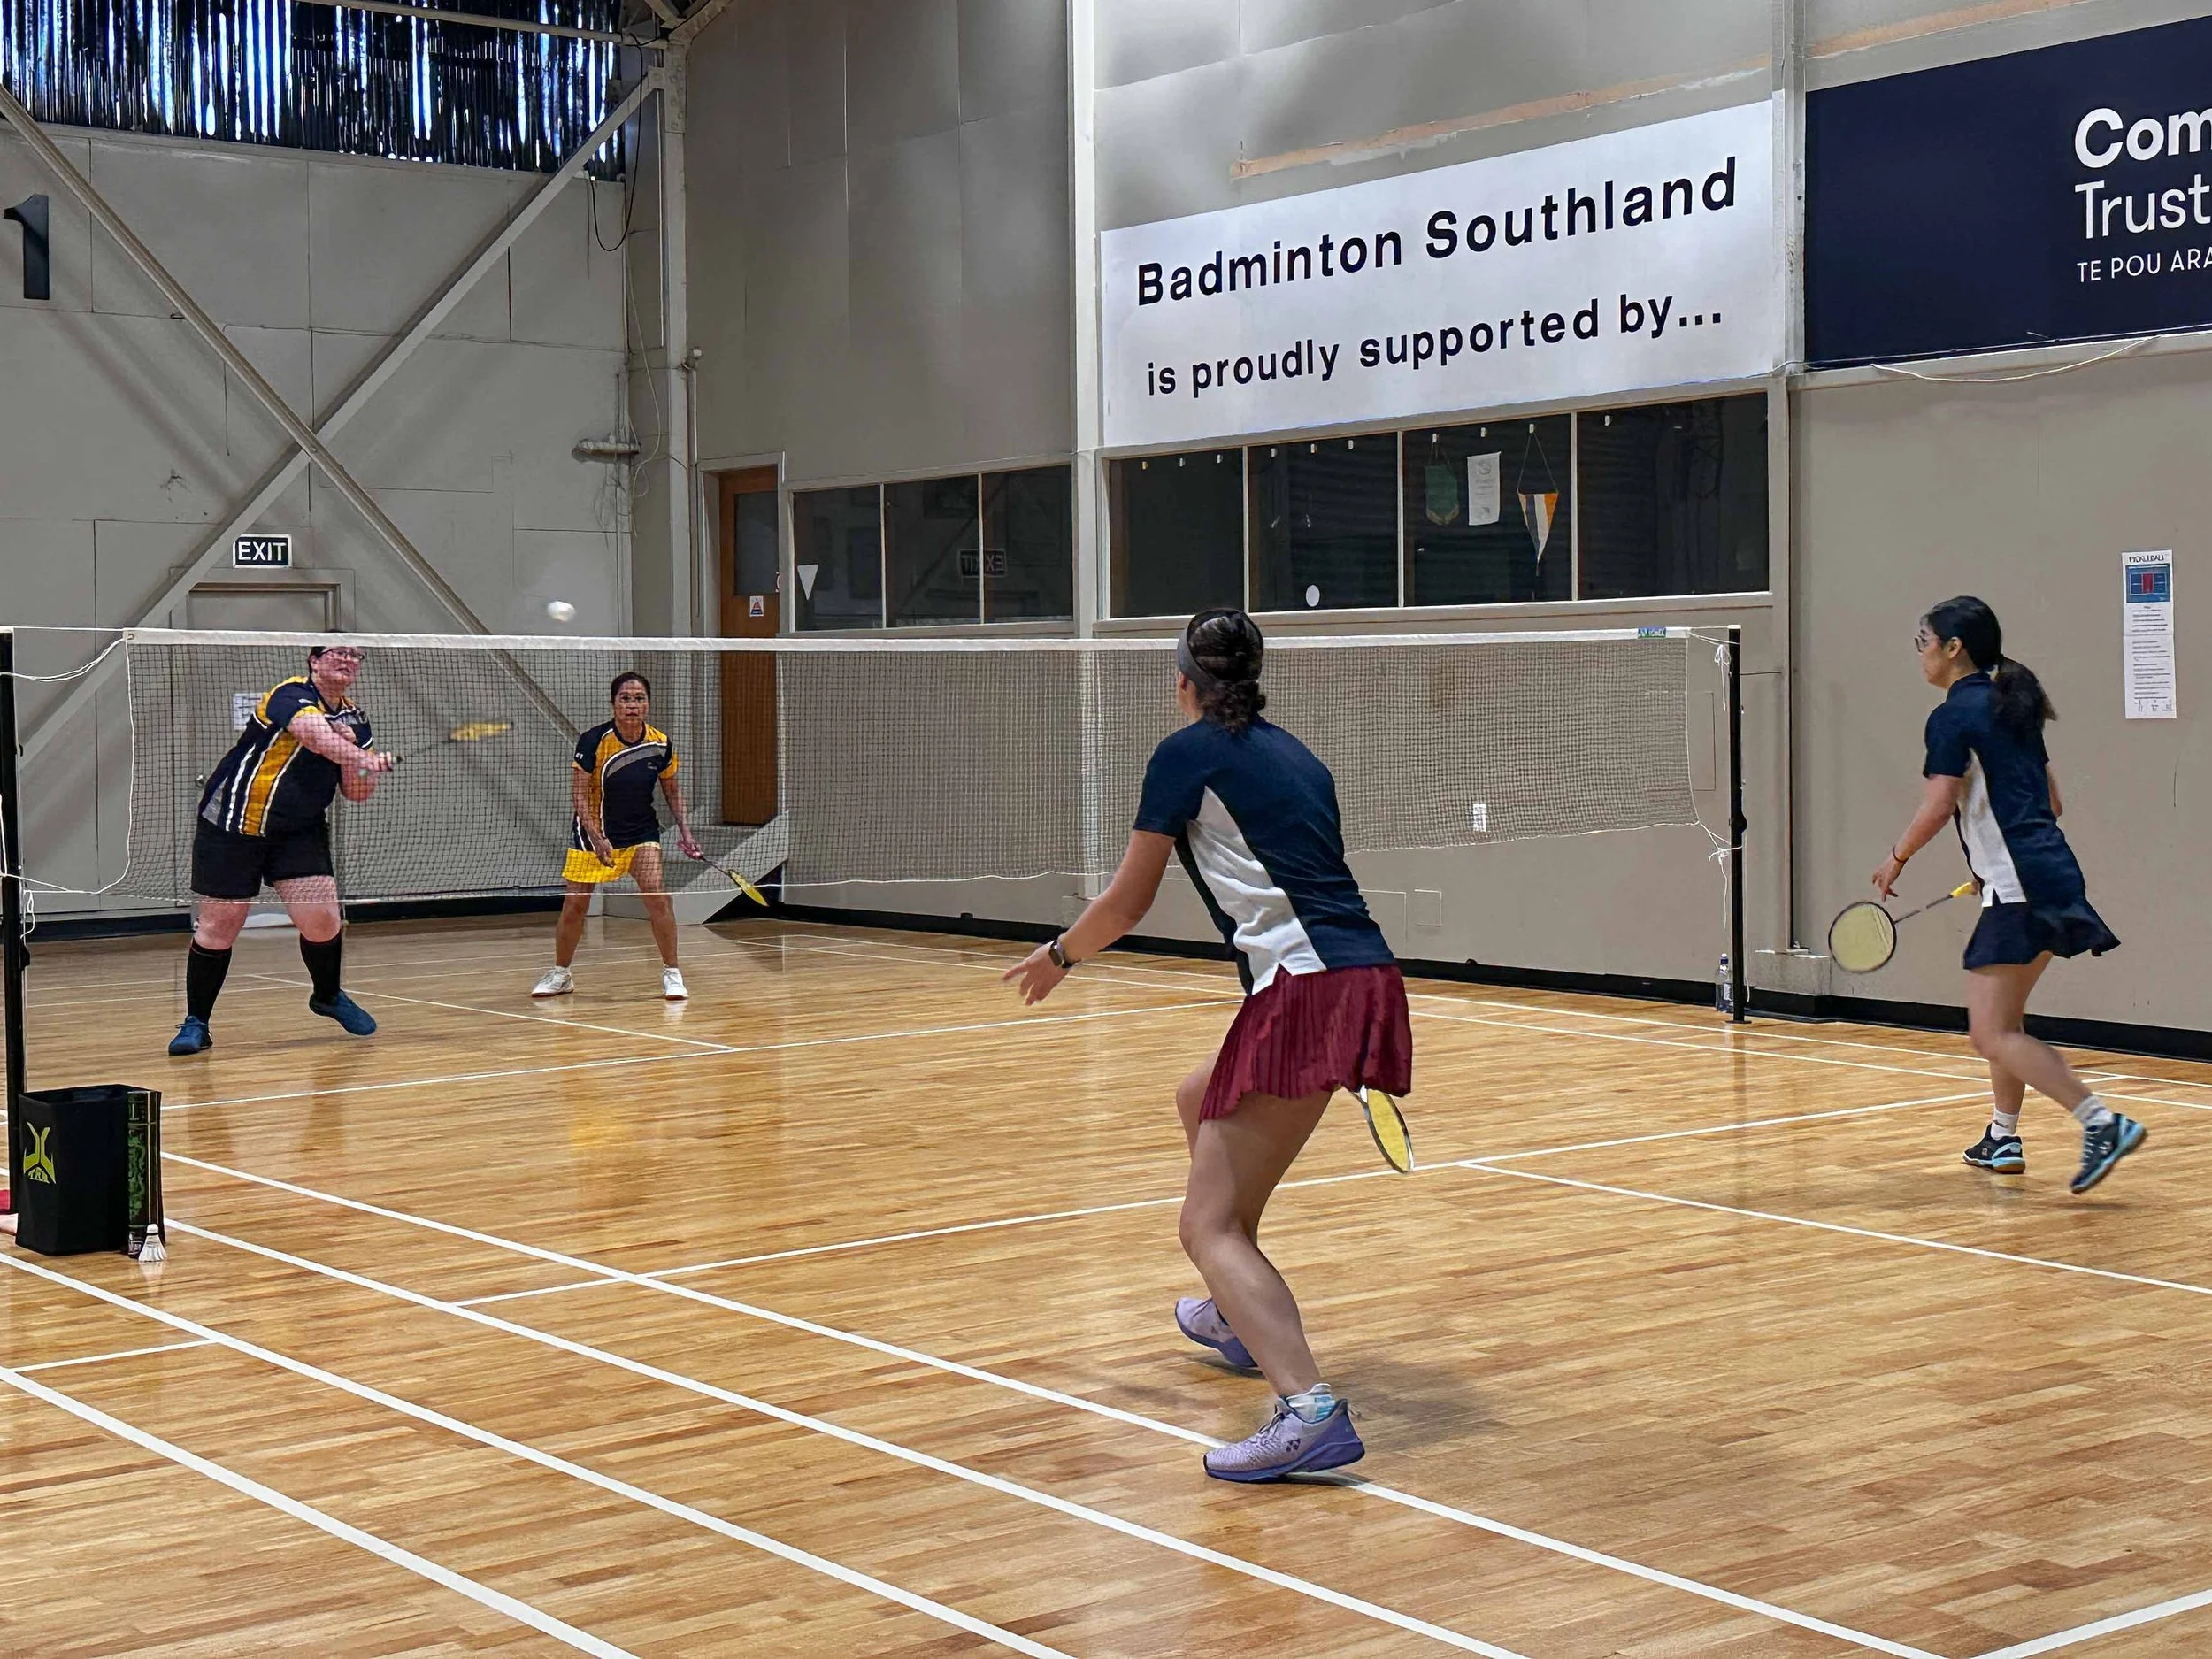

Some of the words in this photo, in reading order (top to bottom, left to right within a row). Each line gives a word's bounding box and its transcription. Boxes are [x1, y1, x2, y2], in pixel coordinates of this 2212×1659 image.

[4, 194, 50, 300] 1
[1138, 231, 1402, 306] Badminton
[1425, 156, 1737, 259] Southland
[2074, 173, 2211, 239] Trust
[2077, 259, 2101, 283] TE
[2111, 252, 2161, 279] POU
[1148, 361, 1177, 396] is
[1192, 340, 1340, 399] proudly
[1359, 297, 1600, 371] supported
[1620, 292, 1722, 341] by...
[238, 541, 288, 562] EXIT
